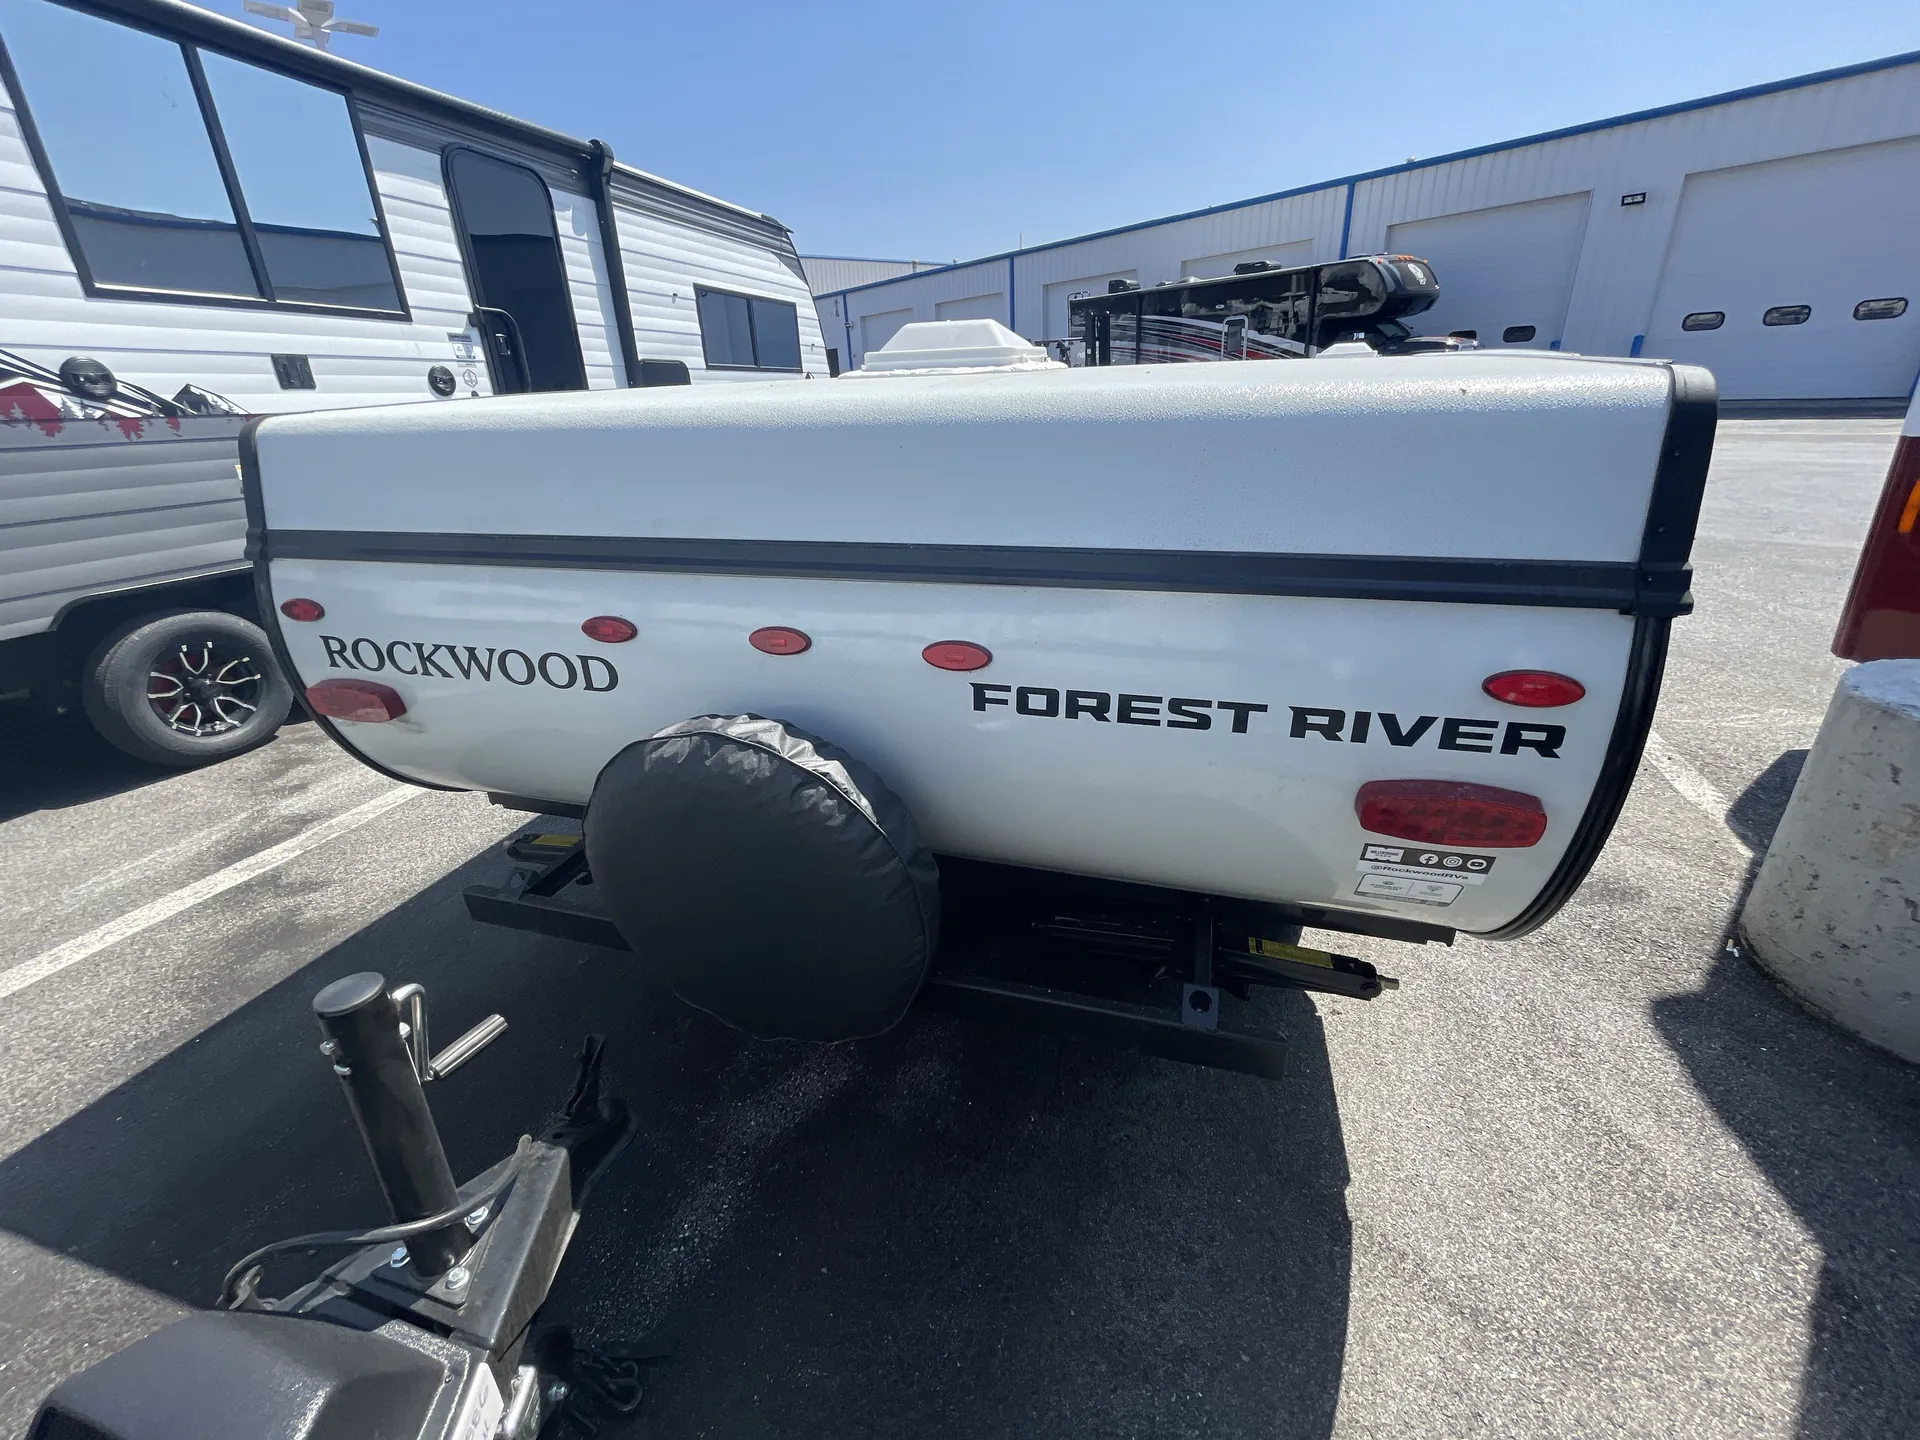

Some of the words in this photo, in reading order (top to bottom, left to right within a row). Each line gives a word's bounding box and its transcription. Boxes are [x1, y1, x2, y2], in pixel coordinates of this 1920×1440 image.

[319, 634, 619, 693] ROCKWOOD
[968, 682, 1269, 734] FOREST
[1288, 705, 1567, 760] RIVER
[1371, 864, 1469, 880] @RockwoodRVs
